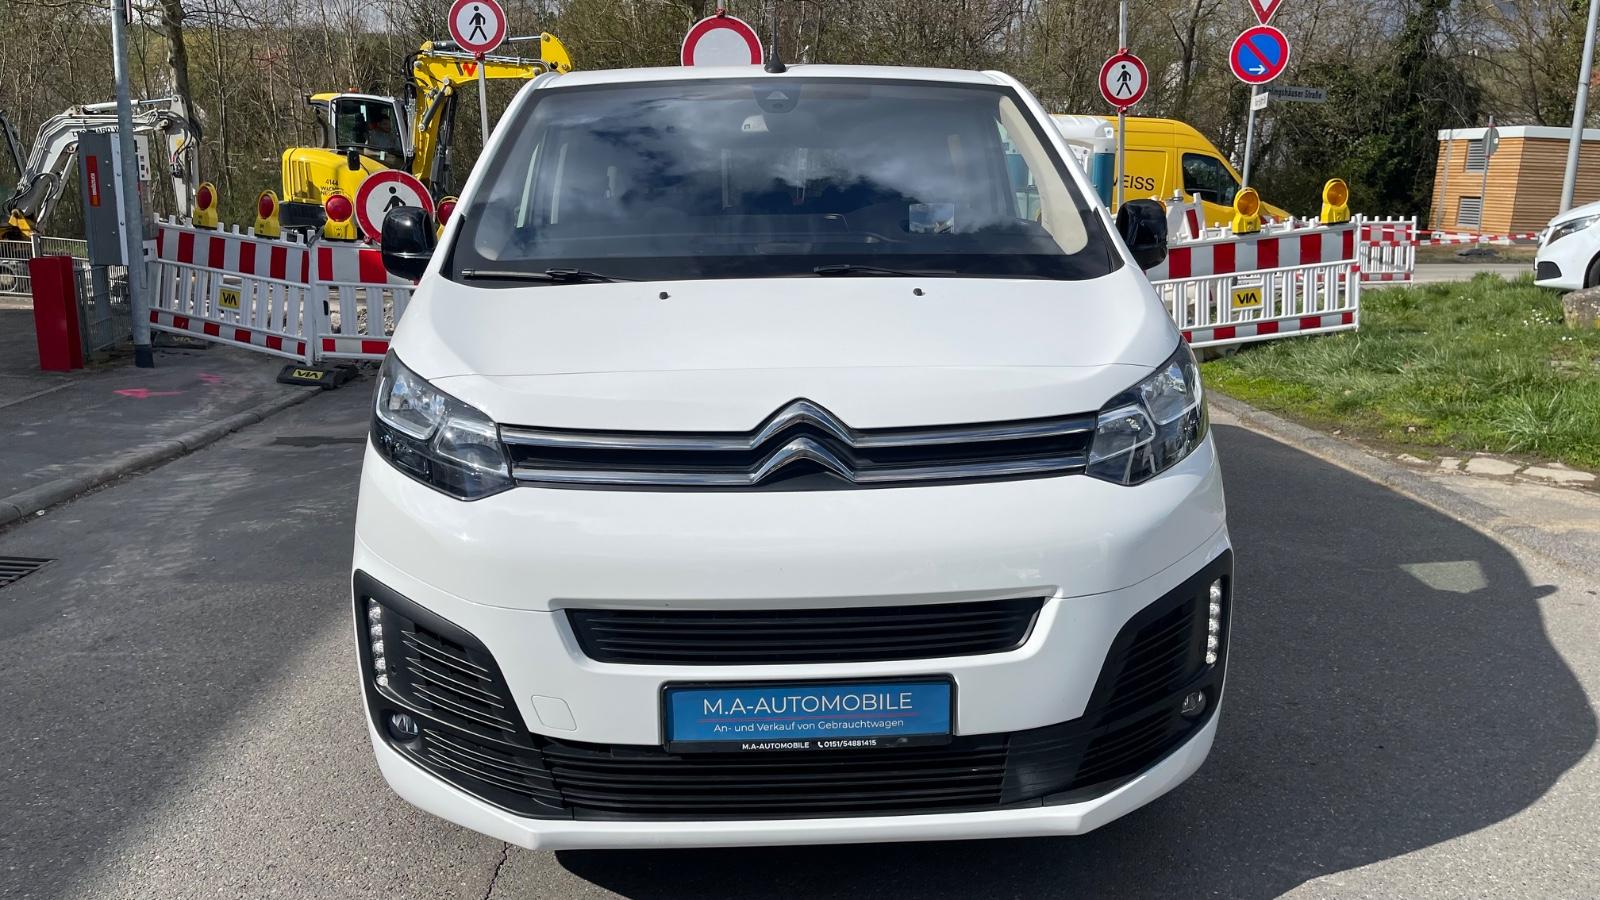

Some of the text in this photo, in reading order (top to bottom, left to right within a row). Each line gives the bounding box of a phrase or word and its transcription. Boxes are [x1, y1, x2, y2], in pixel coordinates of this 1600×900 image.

[1113, 175, 1155, 191] EISS
[222, 291, 237, 306] VIA
[1236, 292, 1258, 305] VIA
[297, 369, 319, 379] VIA
[703, 692, 913, 715] M.A-AUTOMOBILE
[713, 719, 904, 733] An- und Verkauf von Gebrauchtwagen
[742, 741, 810, 751] M.A-AUTOMOBILE
